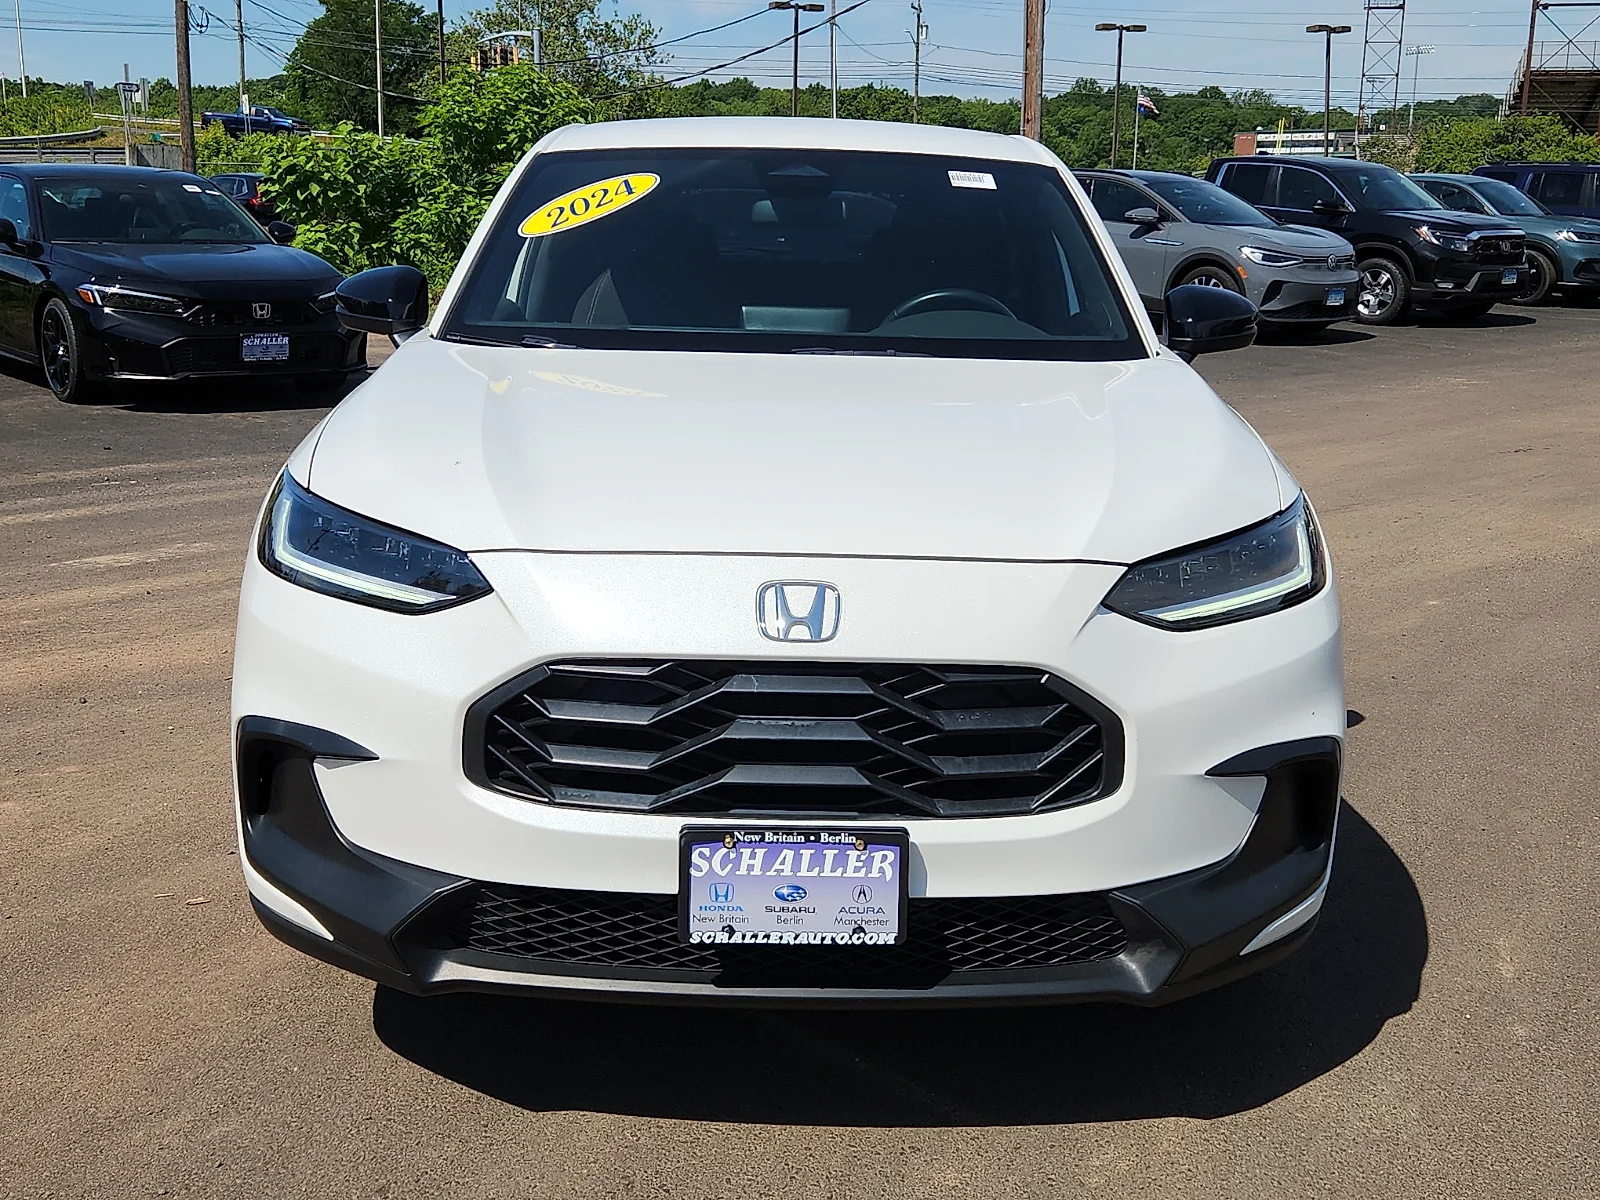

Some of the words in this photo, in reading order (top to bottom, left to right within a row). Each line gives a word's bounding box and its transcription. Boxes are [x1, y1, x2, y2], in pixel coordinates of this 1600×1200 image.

[546, 178, 638, 229] 2024
[243, 337, 289, 346] SCHALLER
[734, 831, 762, 842] New
[764, 832, 806, 843] Britain
[820, 832, 857, 844] Berlin
[689, 847, 895, 882] SCHALLER
[765, 905, 817, 914] SUBARU
[838, 906, 886, 915] ACURA
[692, 914, 716, 924] New
[719, 914, 750, 924] Britain
[776, 915, 804, 925] Berlin
[834, 916, 890, 926] Manchester
[690, 931, 898, 945] SCHALLERAUTO.COM
